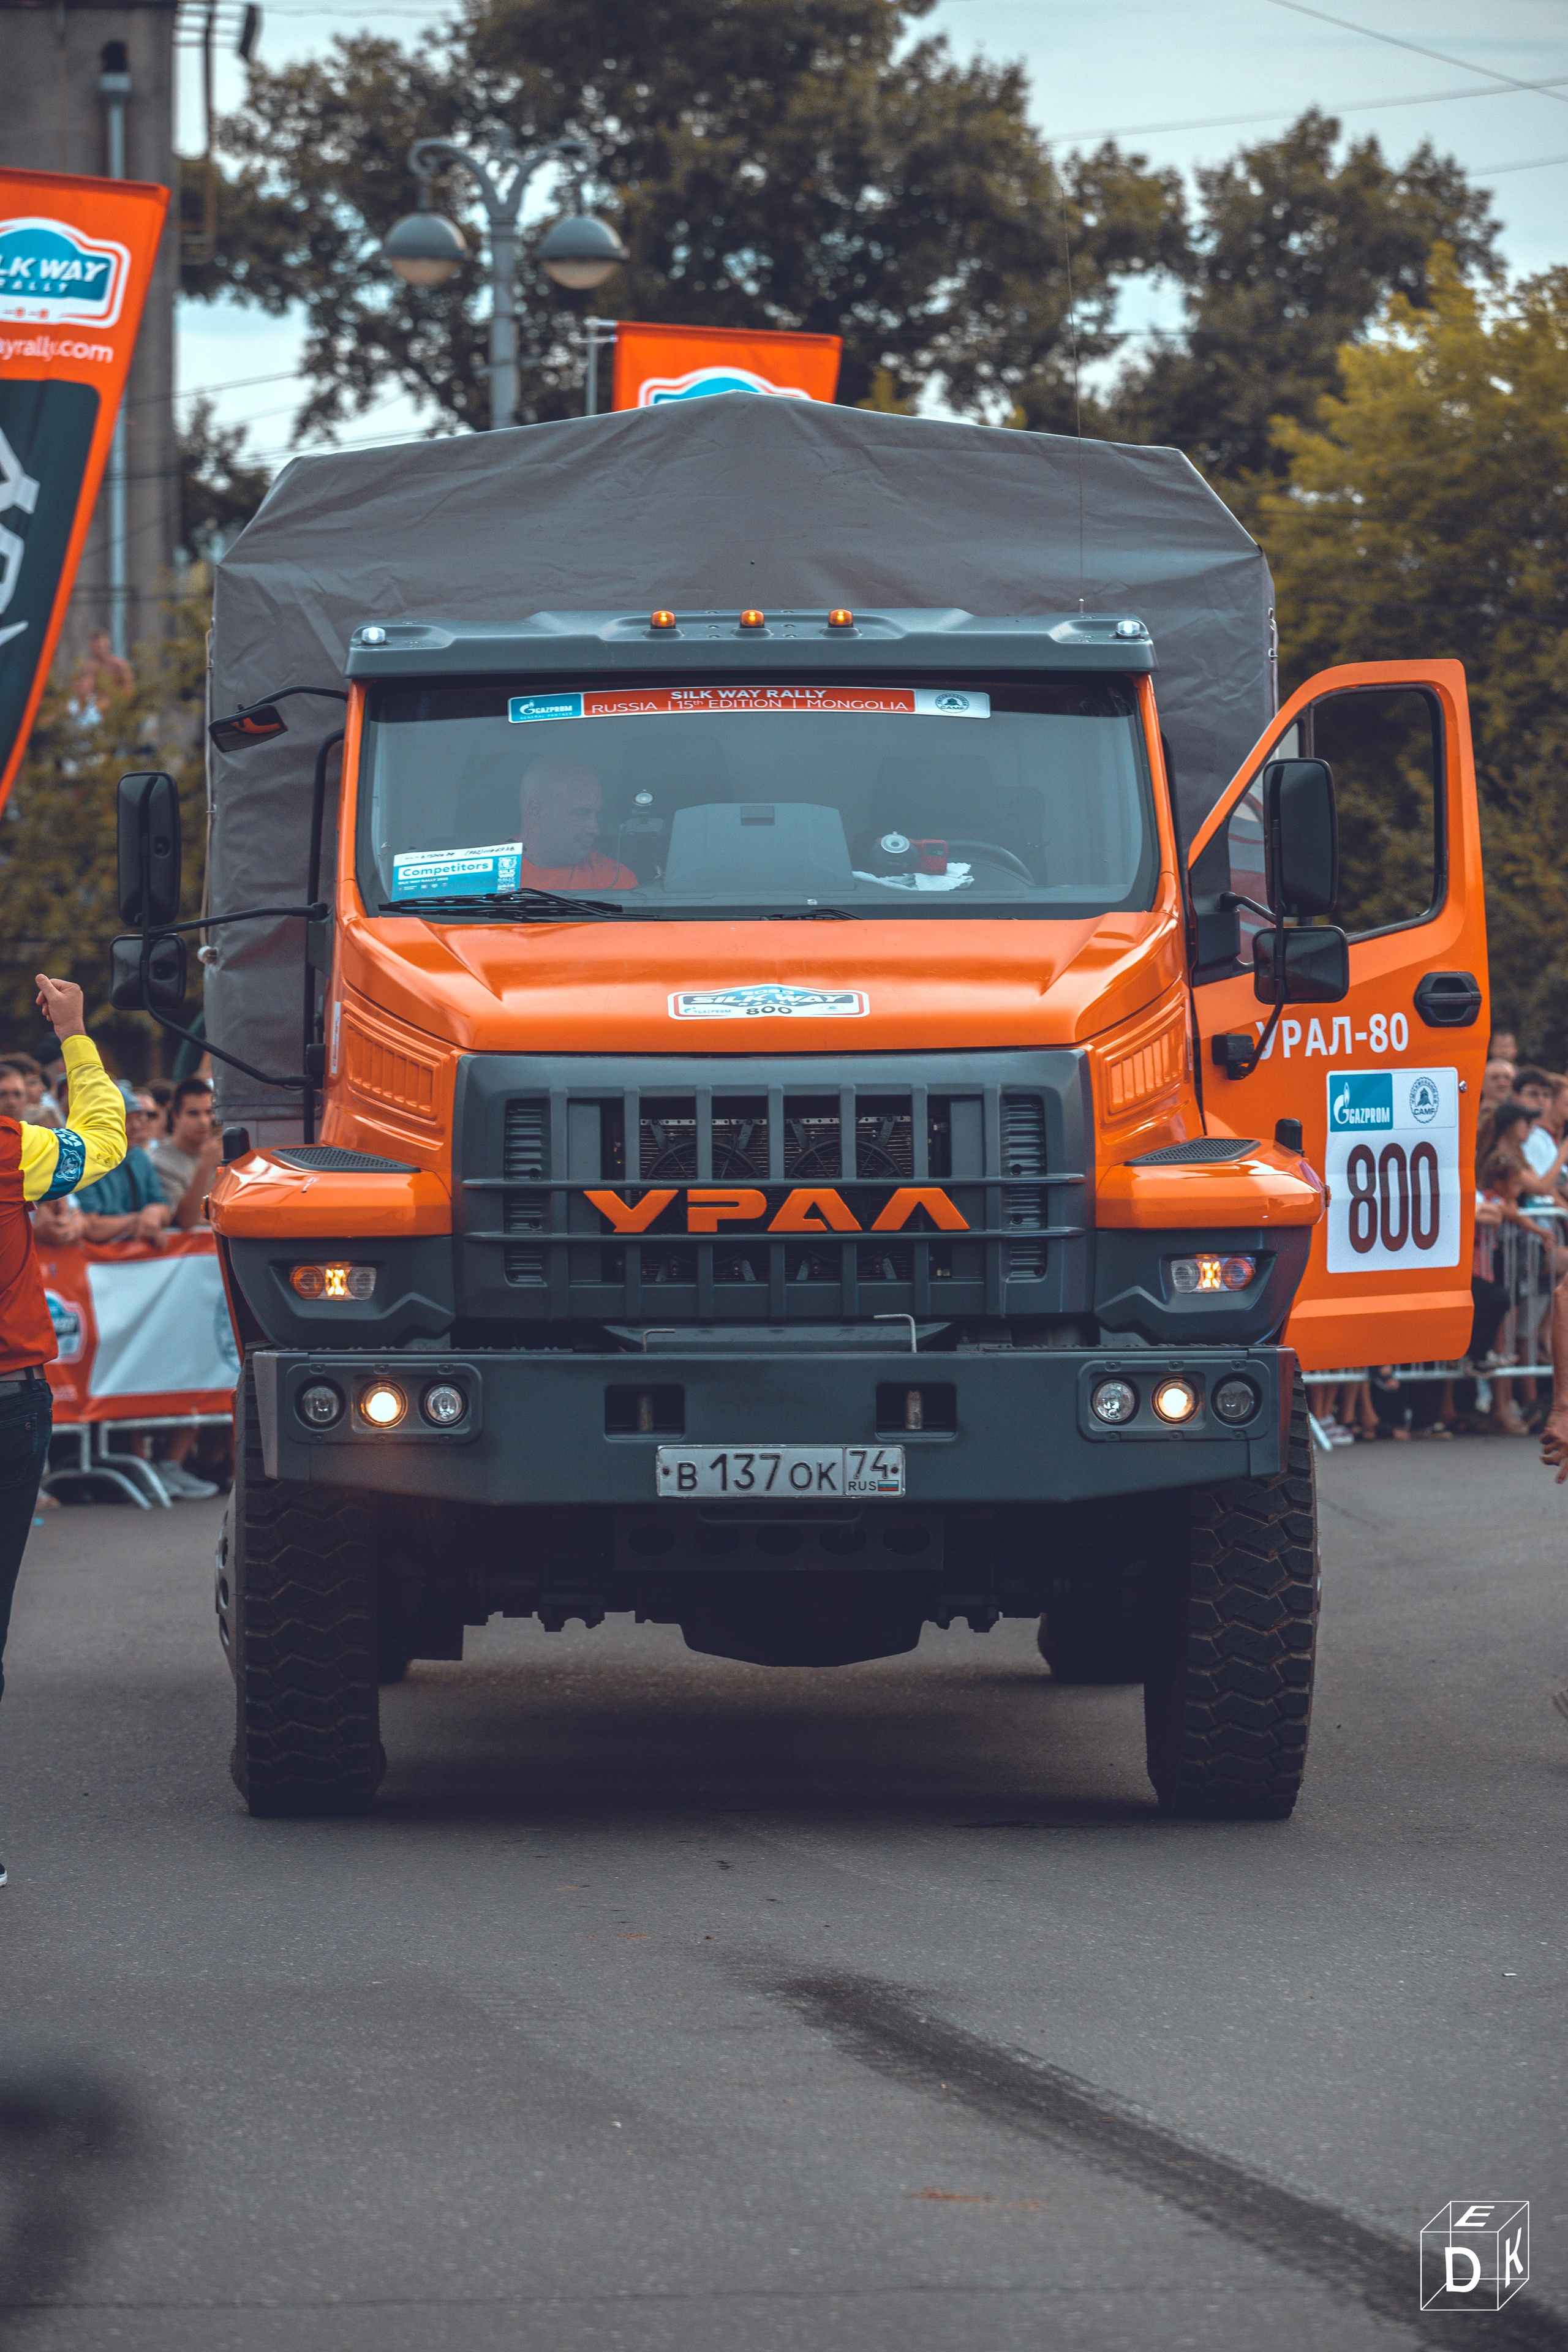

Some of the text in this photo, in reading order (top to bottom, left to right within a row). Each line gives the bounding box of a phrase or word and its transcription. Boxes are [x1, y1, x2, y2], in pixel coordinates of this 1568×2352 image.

[40, 258, 109, 283] WAY
[671, 690, 827, 699] SILK WAY RALLY
[535, 705, 573, 714] GAZPROM
[592, 699, 908, 714] RUSSIA 15th EDITION MONGOLIA
[403, 863, 489, 876] Competitors
[691, 993, 846, 1003] SILK WAY
[746, 1006, 793, 1015] 800
[1349, 1107, 1390, 1124] GAZPROM
[1347, 1141, 1439, 1253] 800
[582, 1188, 971, 1233] УРАЛ
[848, 1449, 889, 1480] 74
[848, 1480, 876, 1491] RUS
